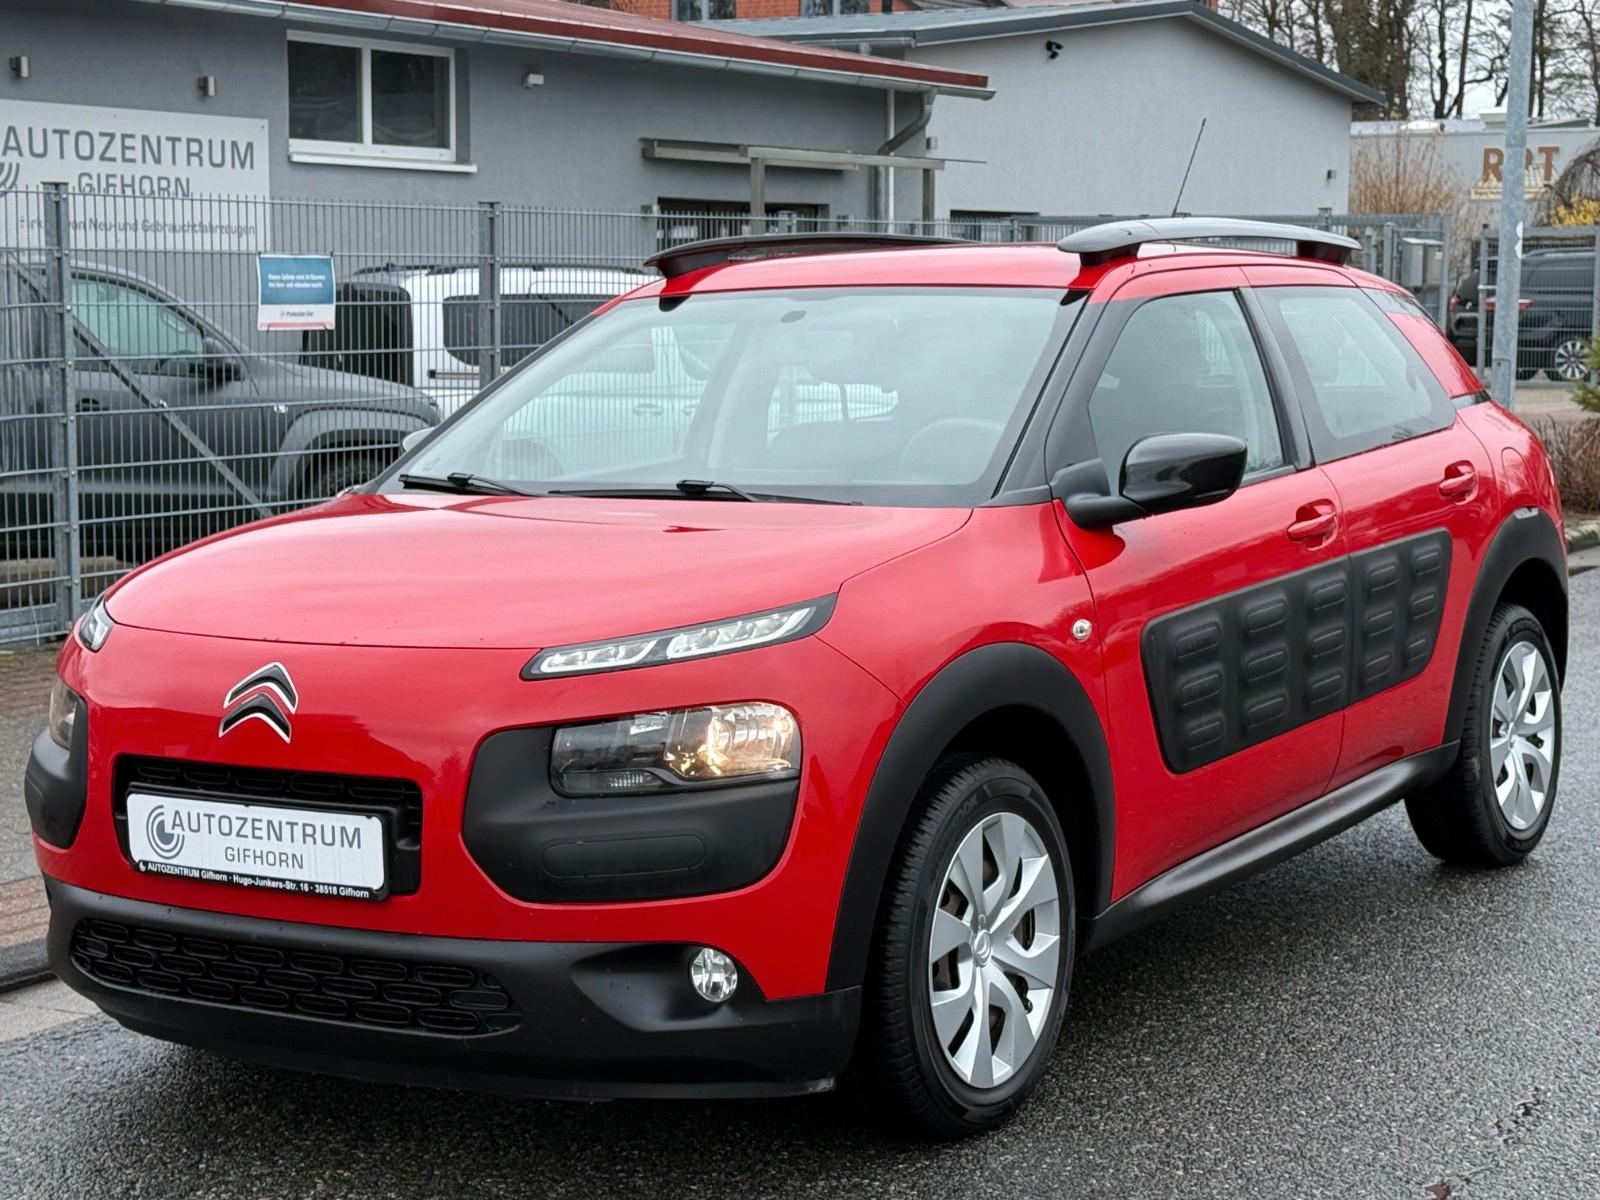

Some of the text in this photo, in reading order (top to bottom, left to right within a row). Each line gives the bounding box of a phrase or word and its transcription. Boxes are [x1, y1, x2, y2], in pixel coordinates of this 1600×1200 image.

[2, 125, 255, 170] AUTOZENTRUM
[78, 172, 190, 198] GIFHORN
[141, 219, 256, 238] Gebrauchtfahrzeugen
[171, 810, 362, 849] AUTOZENTRUM
[224, 846, 304, 870] GIFHORN
[147, 862, 369, 898] AUTOZENTRUM Gifhorn Hugo-Junkers-Str. 16 38518 Gifhorn
